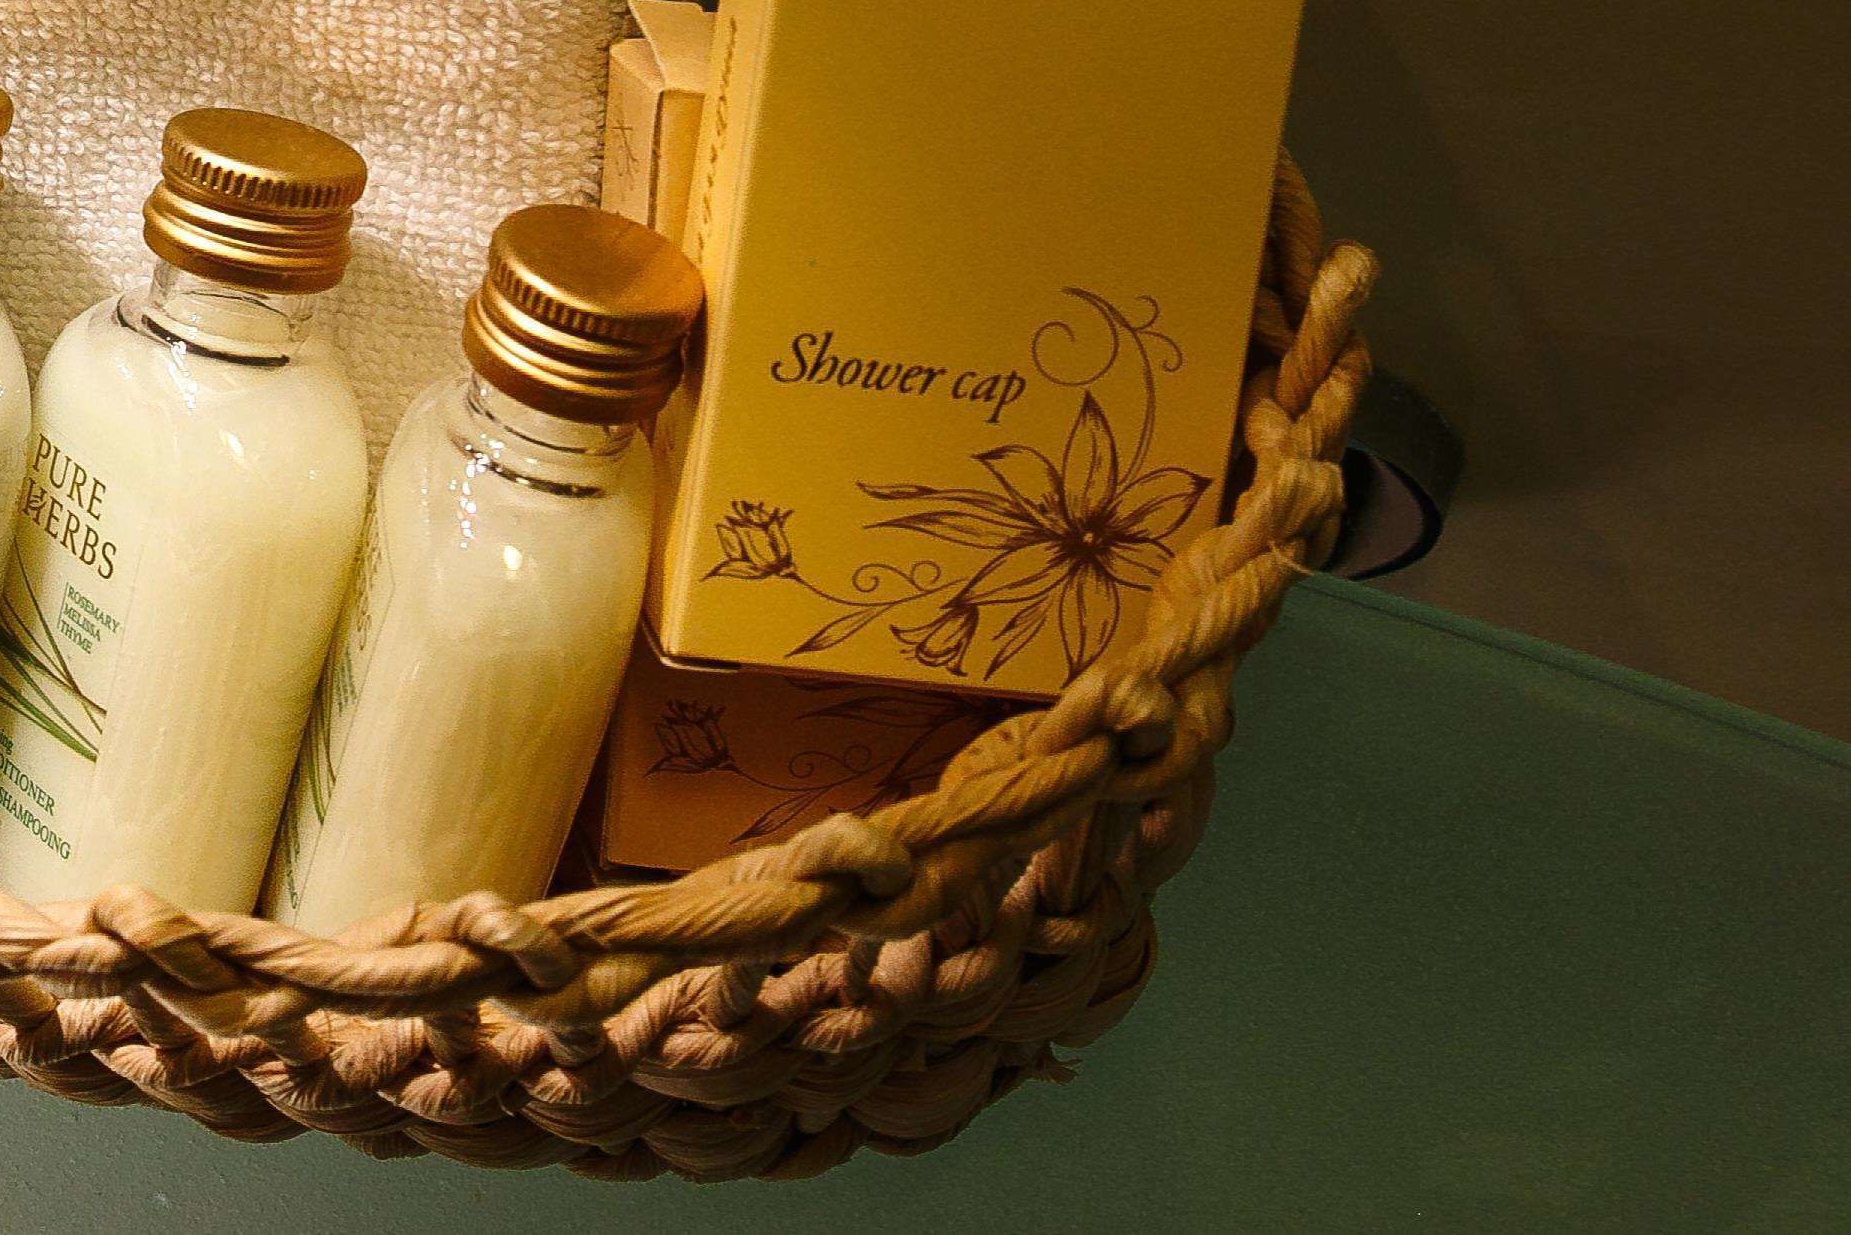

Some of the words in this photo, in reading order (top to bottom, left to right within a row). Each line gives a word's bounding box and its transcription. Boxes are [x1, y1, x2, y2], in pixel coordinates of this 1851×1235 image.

[770, 330, 947, 396] Shower
[951, 370, 1027, 423] cap
[32, 433, 106, 521] PURE
[21, 477, 117, 579] HERBS
[60, 619, 93, 654] THYME
[64, 603, 101, 642] MELISSA
[67, 586, 120, 633] ROSEMARY
